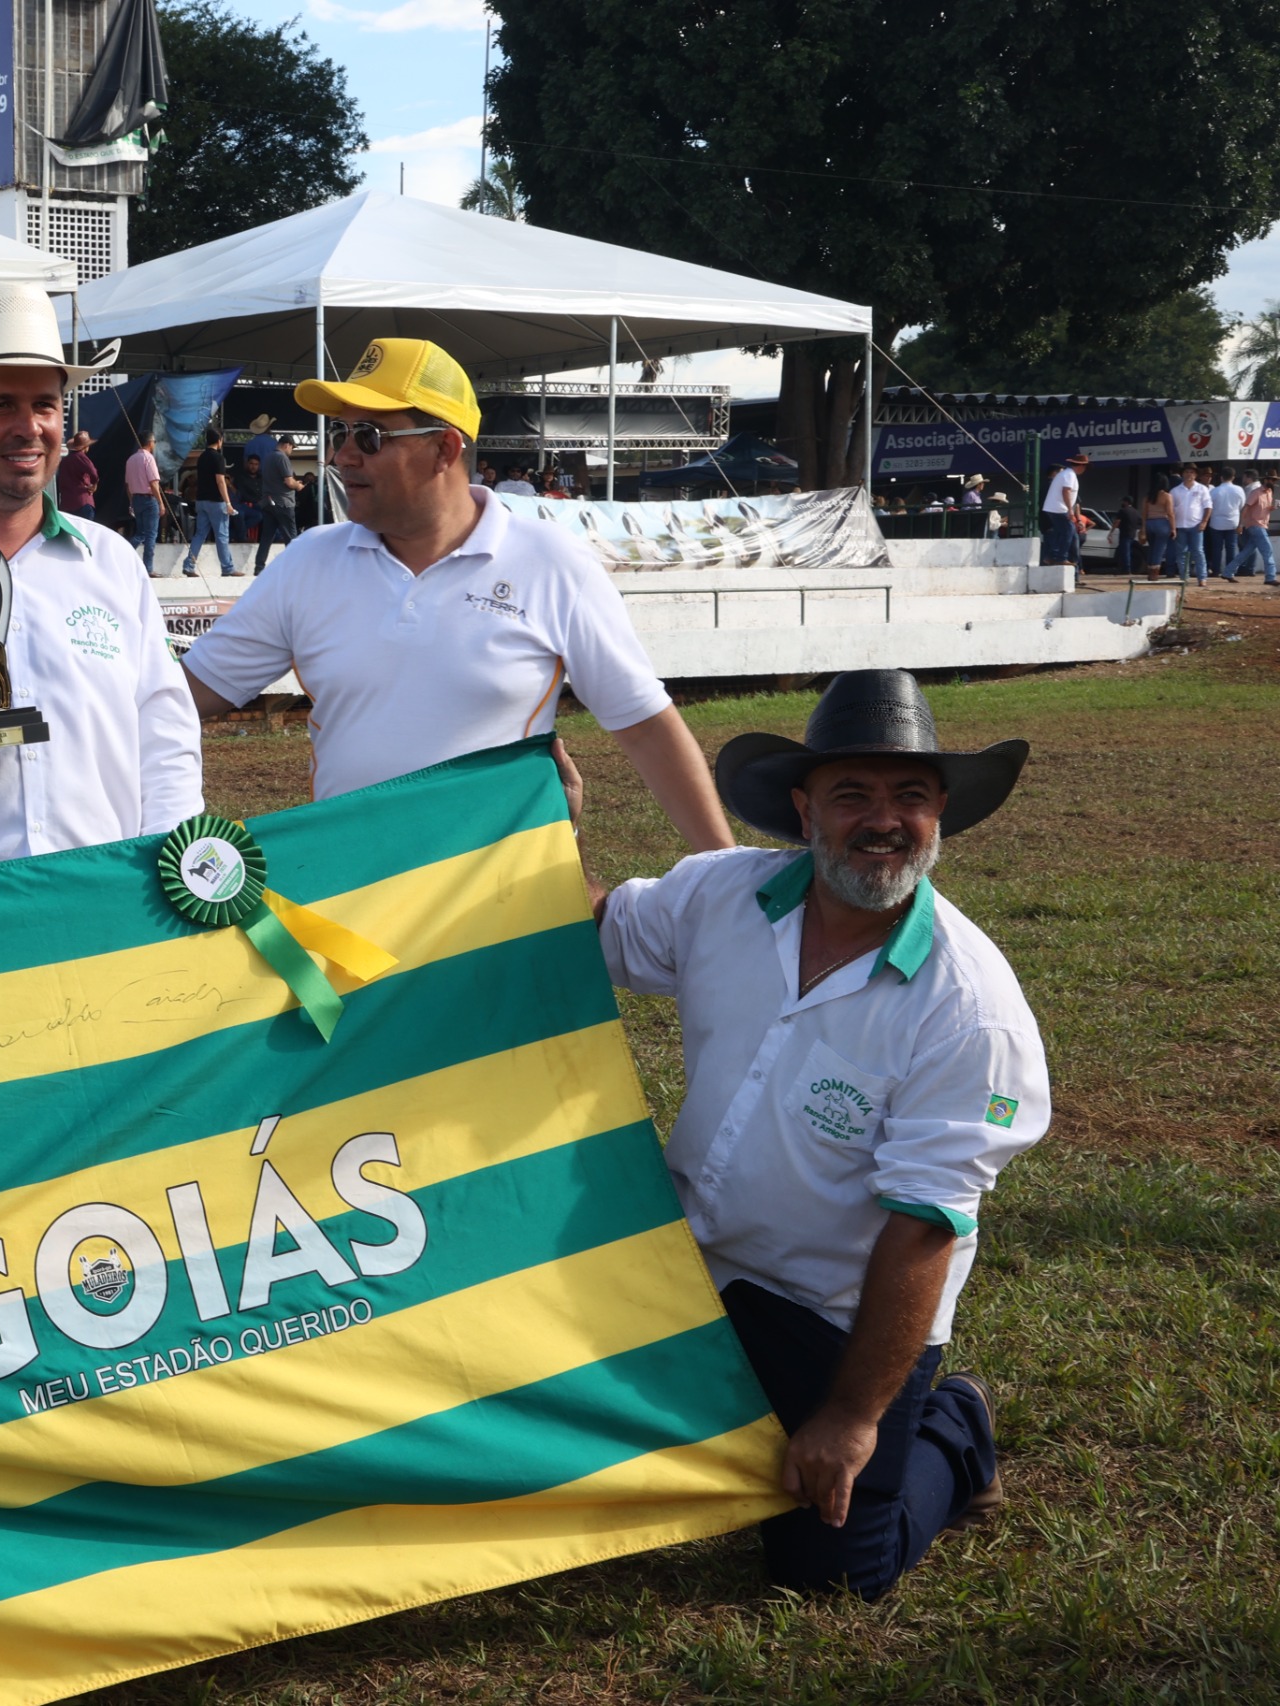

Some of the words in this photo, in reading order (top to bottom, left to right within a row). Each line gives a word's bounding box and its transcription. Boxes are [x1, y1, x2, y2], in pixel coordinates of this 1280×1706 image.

[885, 429, 974, 451] Associação
[977, 426, 1037, 444] Goiana
[1041, 423, 1062, 439] de
[1065, 418, 1162, 439] Avicultura
[1189, 450, 1210, 458] AGA
[65, 606, 119, 631] COMITIVA
[190, 605, 202, 614] DA
[204, 605, 218, 613] LEI
[71, 638, 98, 648] Rancho
[810, 1078, 874, 1117] COMITIVA
[803, 1105, 832, 1125] Rancho
[834, 1121, 846, 1131] do
[819, 1123, 851, 1141] Amigos
[82, 1270, 126, 1290] MULADEIROS
[19, 1372, 90, 1416] MEU
[95, 1333, 234, 1392] ESTADÃO
[239, 1297, 374, 1357] QUERIDO
